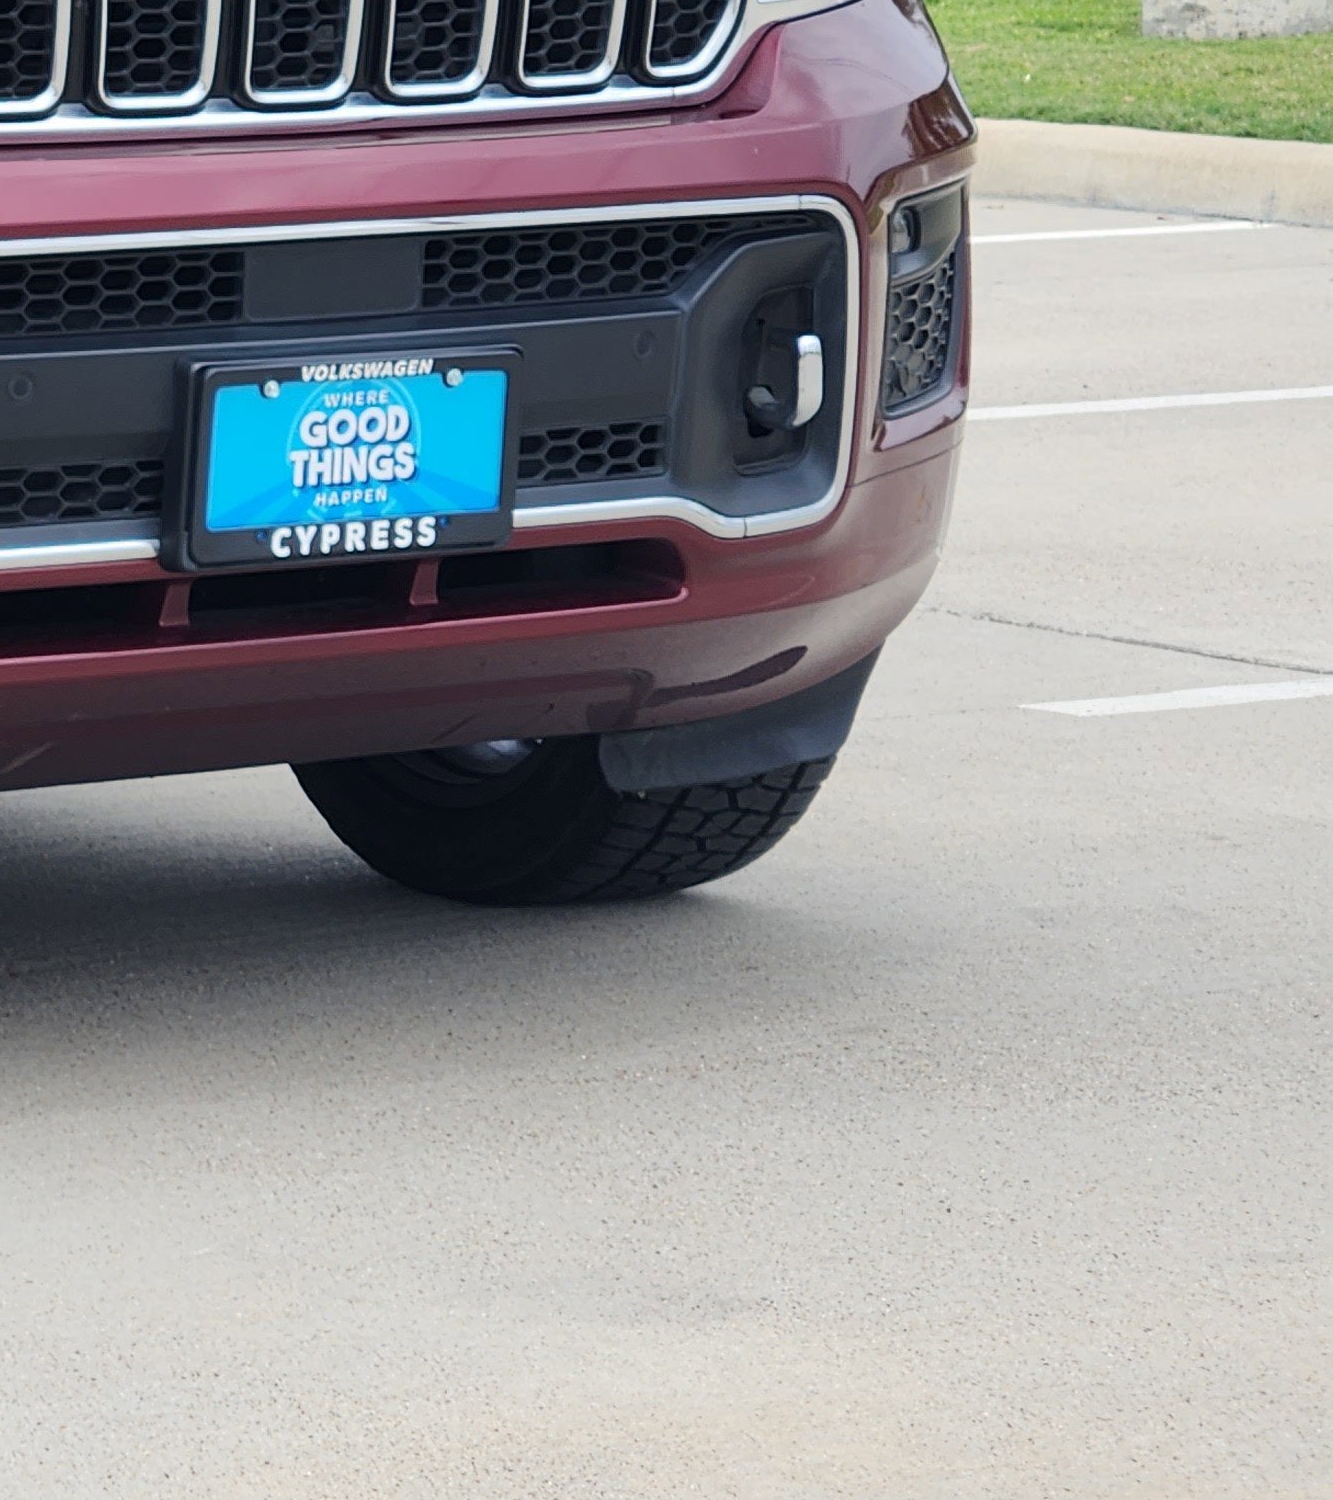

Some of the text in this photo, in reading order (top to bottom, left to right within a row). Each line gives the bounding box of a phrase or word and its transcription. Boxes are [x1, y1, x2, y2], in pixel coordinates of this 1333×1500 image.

[300, 358, 434, 382] VOLKSWAGEN
[324, 389, 390, 408] WHERE
[299, 405, 410, 447] GOOD
[289, 442, 416, 488] THINGS
[314, 486, 388, 507] HAPPEN
[270, 515, 437, 558] CYPRESS
